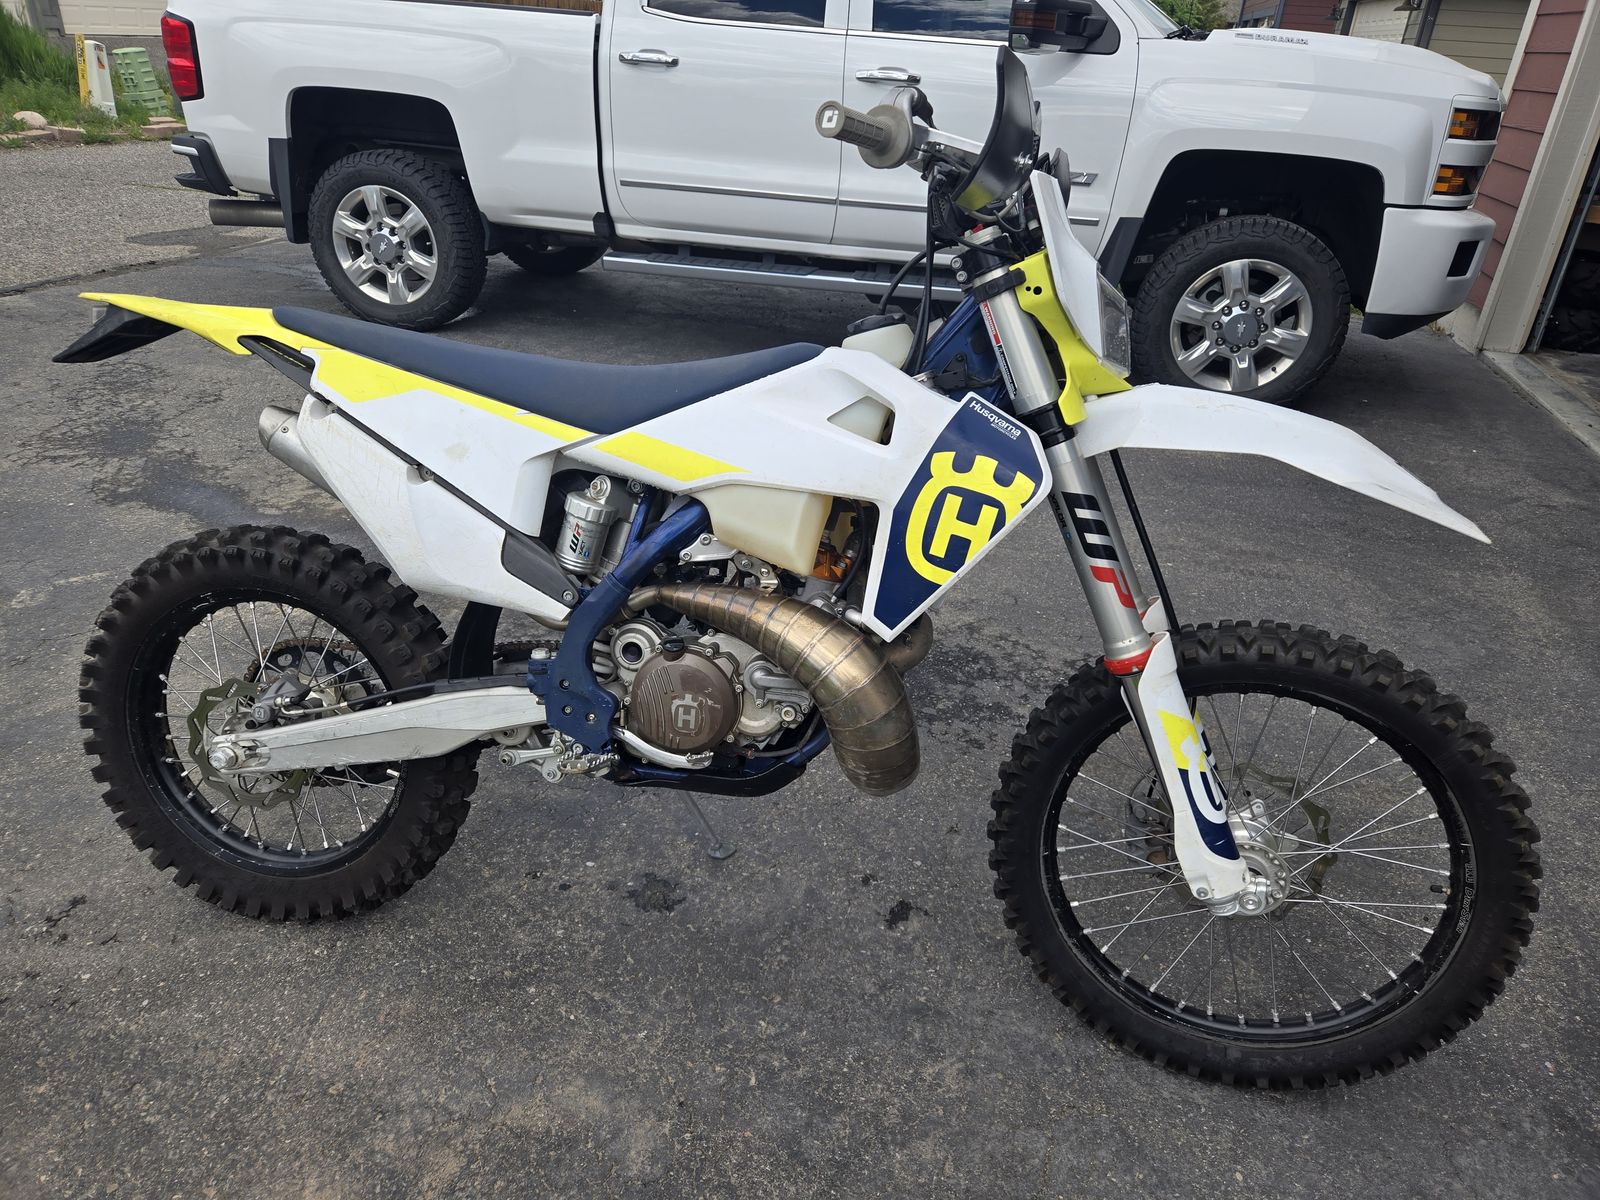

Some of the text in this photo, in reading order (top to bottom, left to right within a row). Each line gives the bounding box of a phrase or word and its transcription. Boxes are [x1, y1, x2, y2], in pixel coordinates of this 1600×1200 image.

[984, 304, 996, 335] WARNING
[969, 400, 1021, 437] Husqvarna
[569, 522, 581, 554] WP
[1061, 491, 1137, 609] WP
